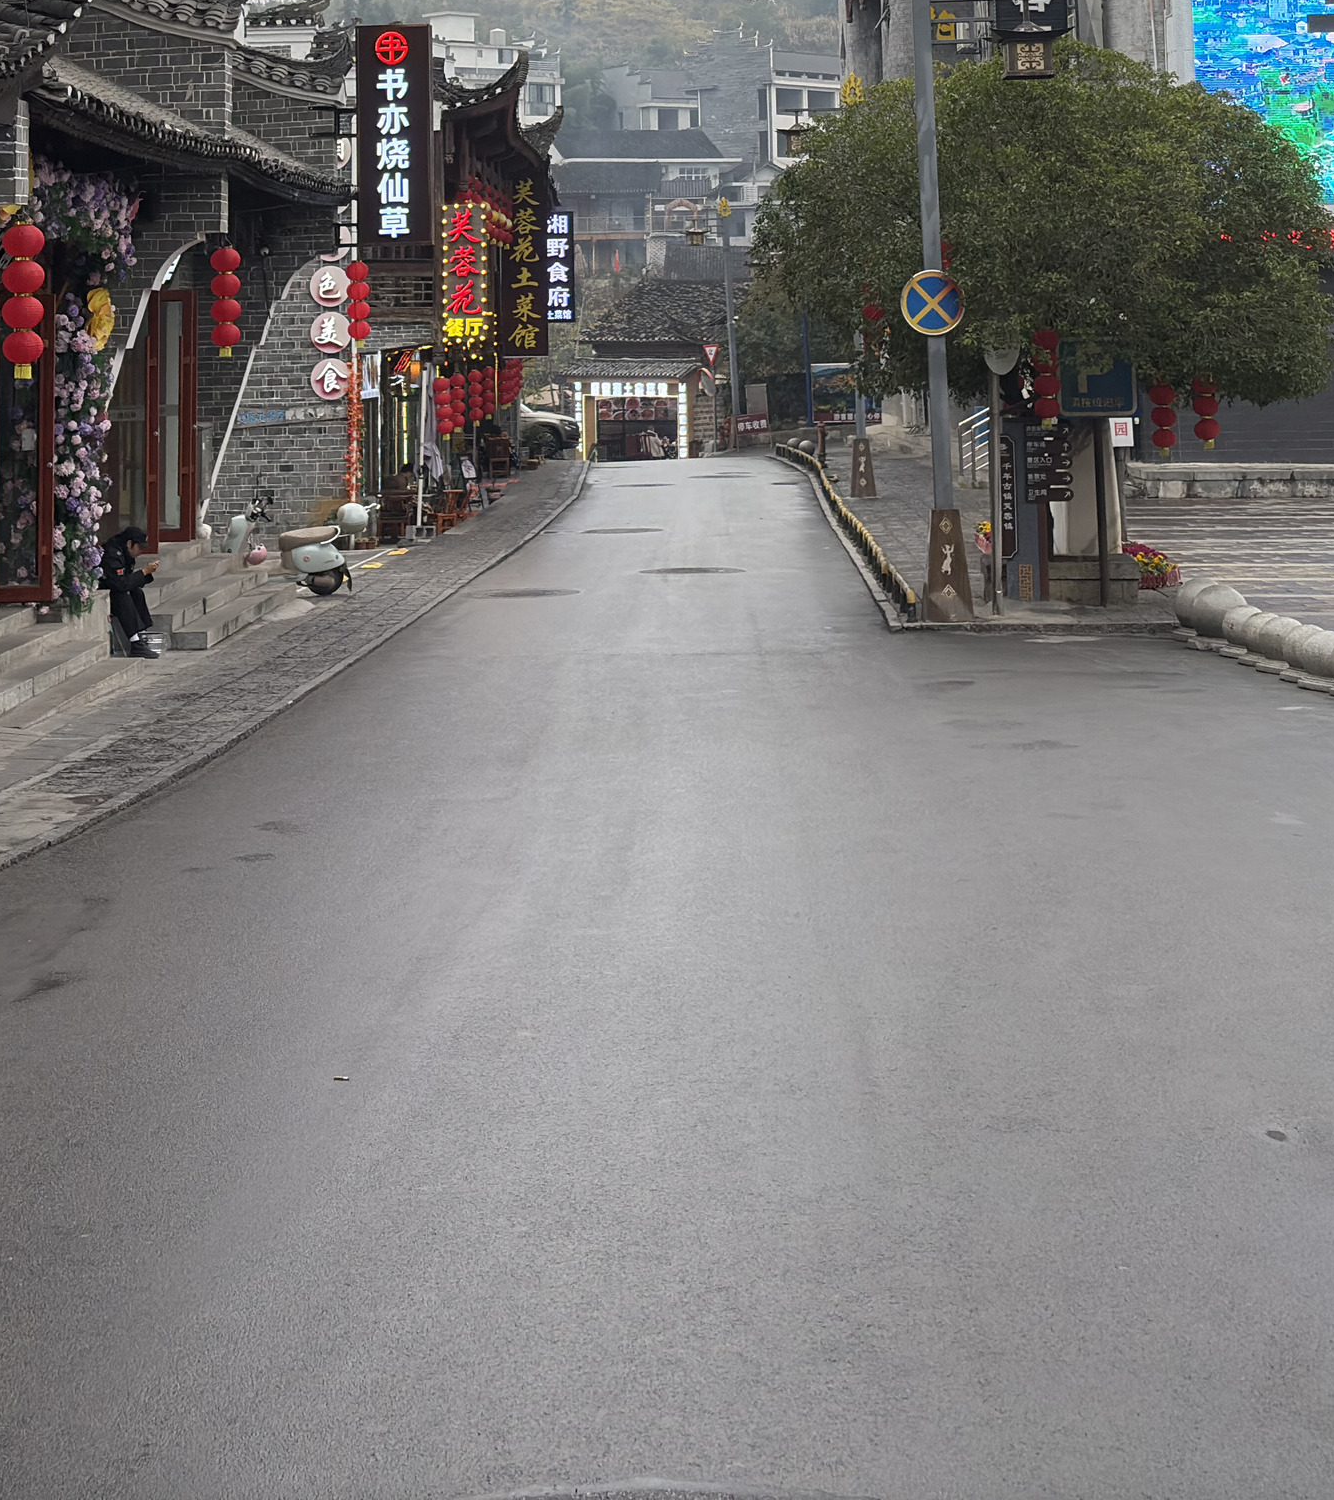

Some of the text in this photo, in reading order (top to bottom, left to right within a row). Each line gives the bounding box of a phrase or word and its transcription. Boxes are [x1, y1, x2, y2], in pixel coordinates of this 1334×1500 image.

[375, 68, 411, 239] 书亦烧仙草
[446, 208, 482, 315] 芙蓉花
[508, 177, 542, 349] 芙蓉花土菜馆
[546, 213, 571, 307] 湘野食府
[445, 317, 484, 338] 餐厅
[737, 419, 768, 432] 停车收费
[1001, 462, 1014, 531] 千年古镇芙蓉镇
